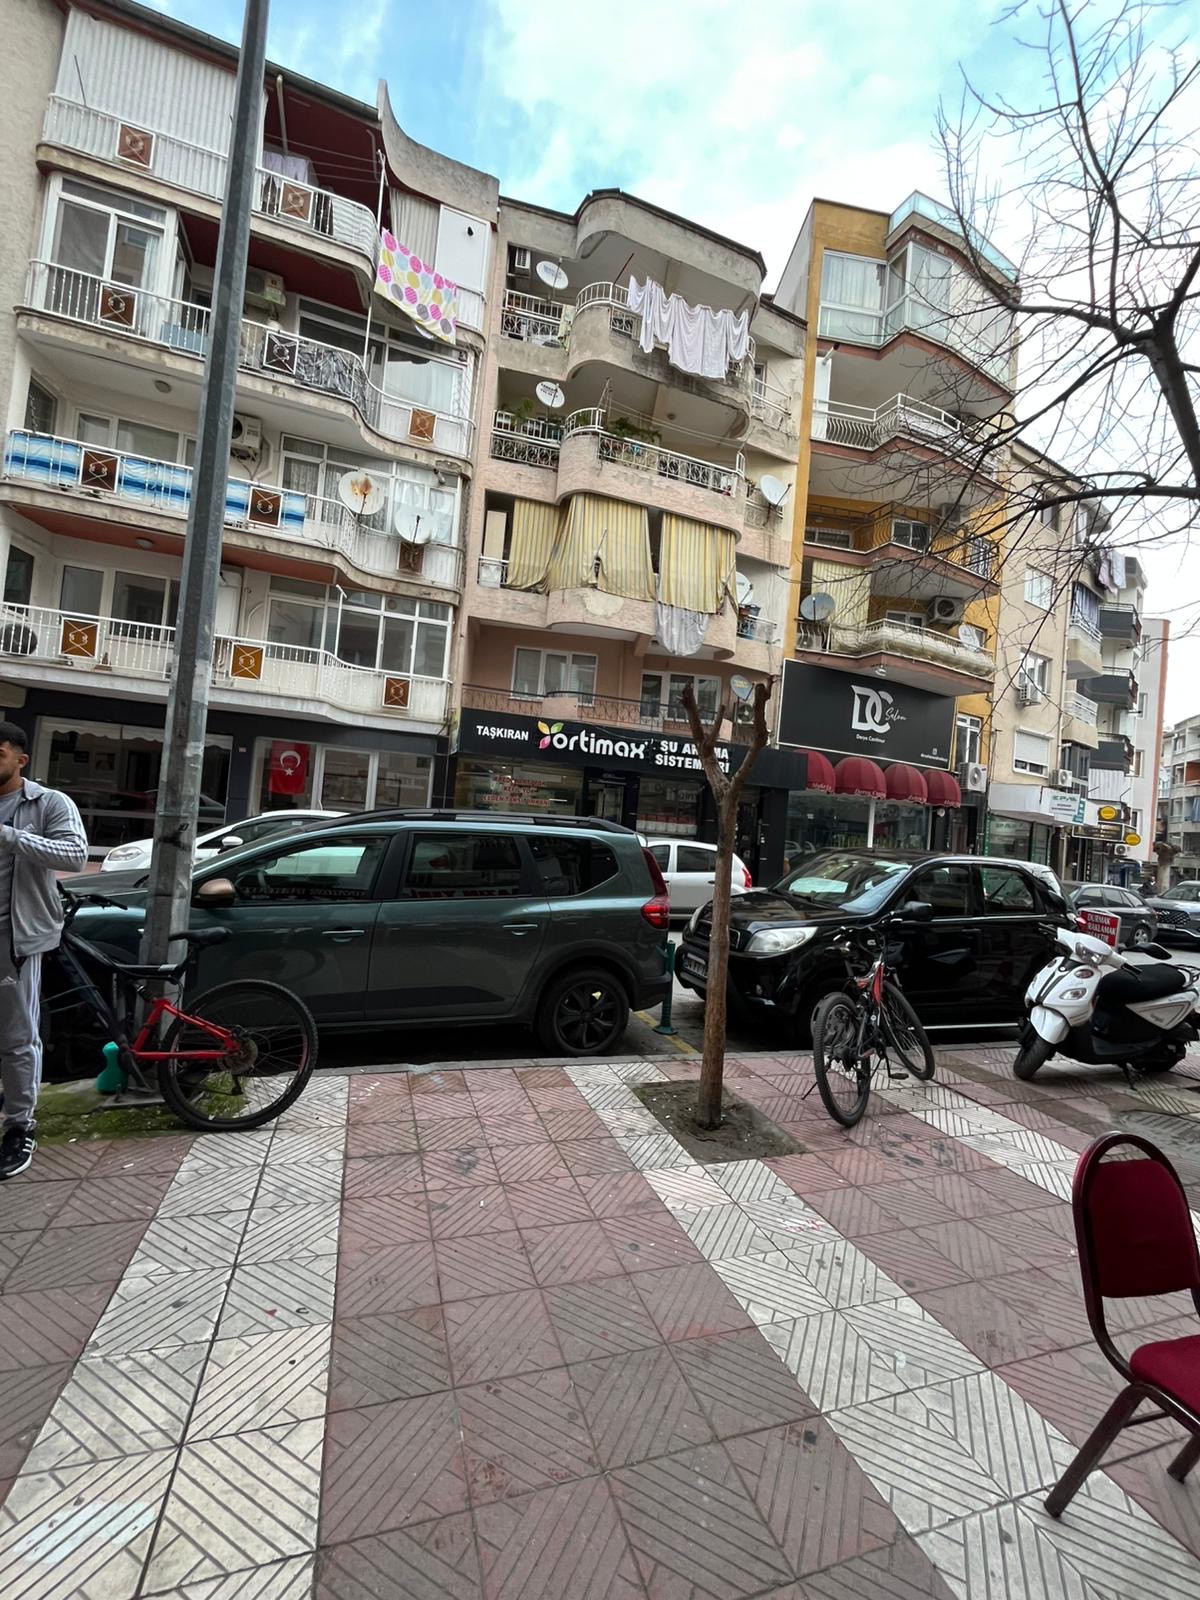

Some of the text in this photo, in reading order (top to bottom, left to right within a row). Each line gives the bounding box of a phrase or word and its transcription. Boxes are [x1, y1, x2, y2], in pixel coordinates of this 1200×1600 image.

[851, 685, 894, 733] DC
[476, 725, 529, 741] TAŞKIRAN
[552, 729, 646, 760] ortimax
[660, 740, 729, 759] SU ARMA
[655, 752, 730, 773] SİSTEMRİ
